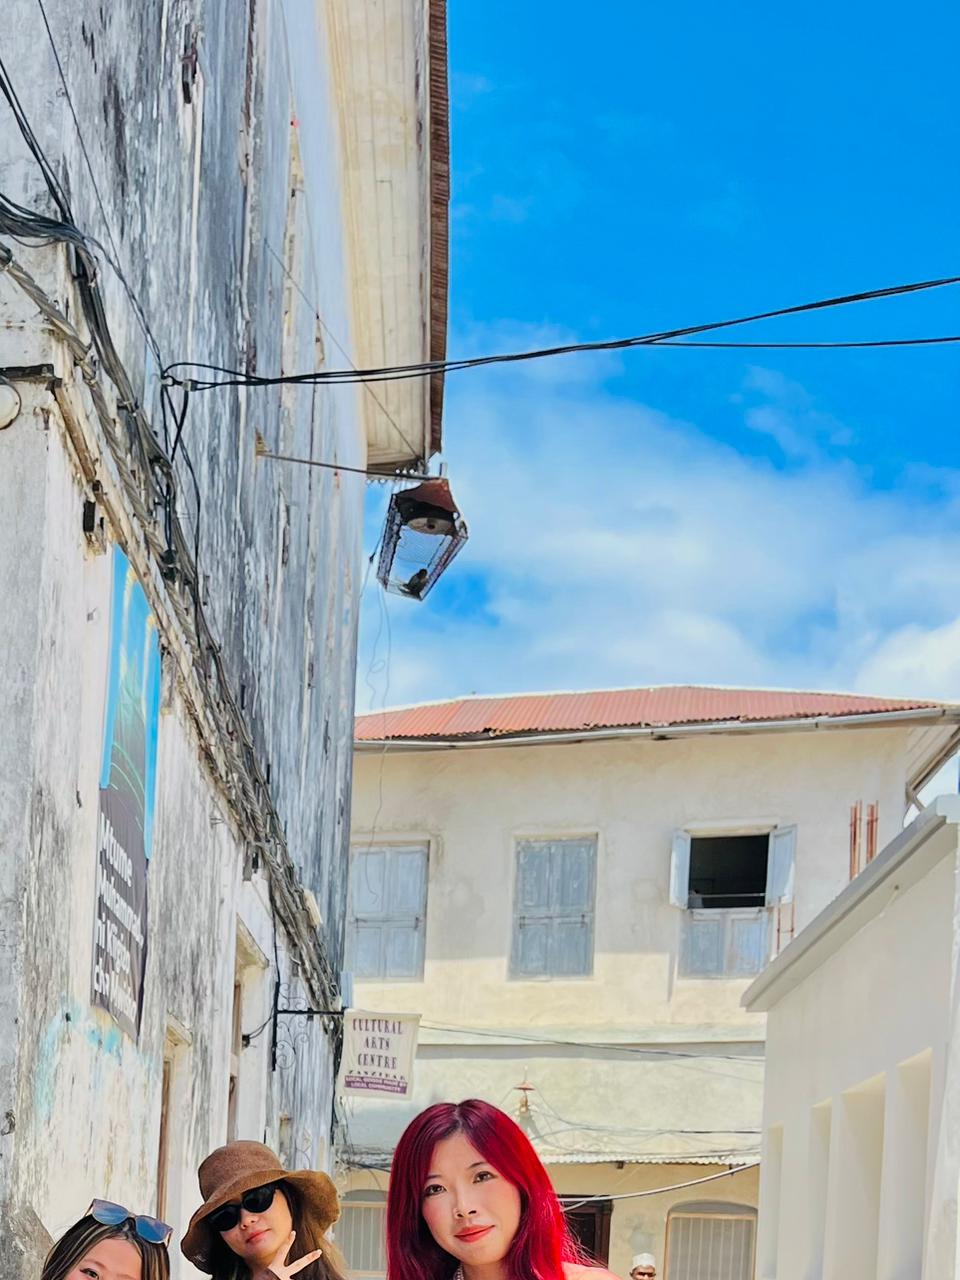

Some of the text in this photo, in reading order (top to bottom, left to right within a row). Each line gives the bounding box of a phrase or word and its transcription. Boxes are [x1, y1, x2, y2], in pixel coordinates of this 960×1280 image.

[100, 812, 132, 887] Mtume
[94, 957, 110, 997] cha
[352, 1018, 403, 1035] CULTURAL
[364, 1037, 391, 1051] ARTS
[357, 1053, 397, 1069] CENTRE
